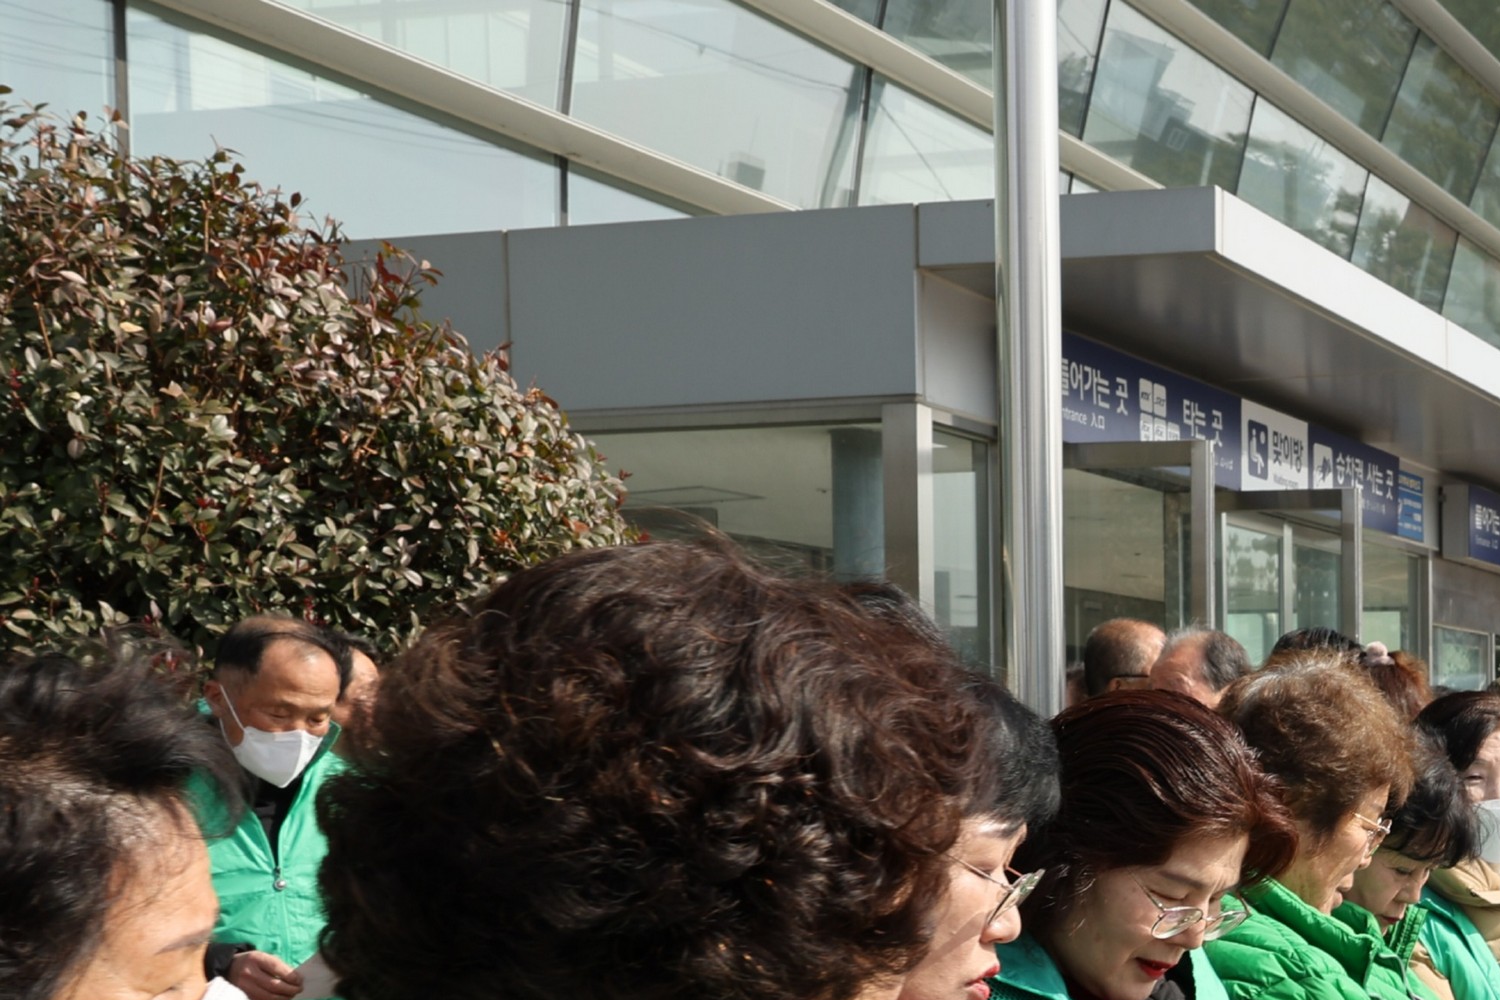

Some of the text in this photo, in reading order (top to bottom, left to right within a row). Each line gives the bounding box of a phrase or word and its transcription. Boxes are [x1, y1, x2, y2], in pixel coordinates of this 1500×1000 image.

[1115, 376, 1128, 416] 곳
[1183, 398, 1206, 440] 타는
[1273, 420, 1304, 474] 맞이방
